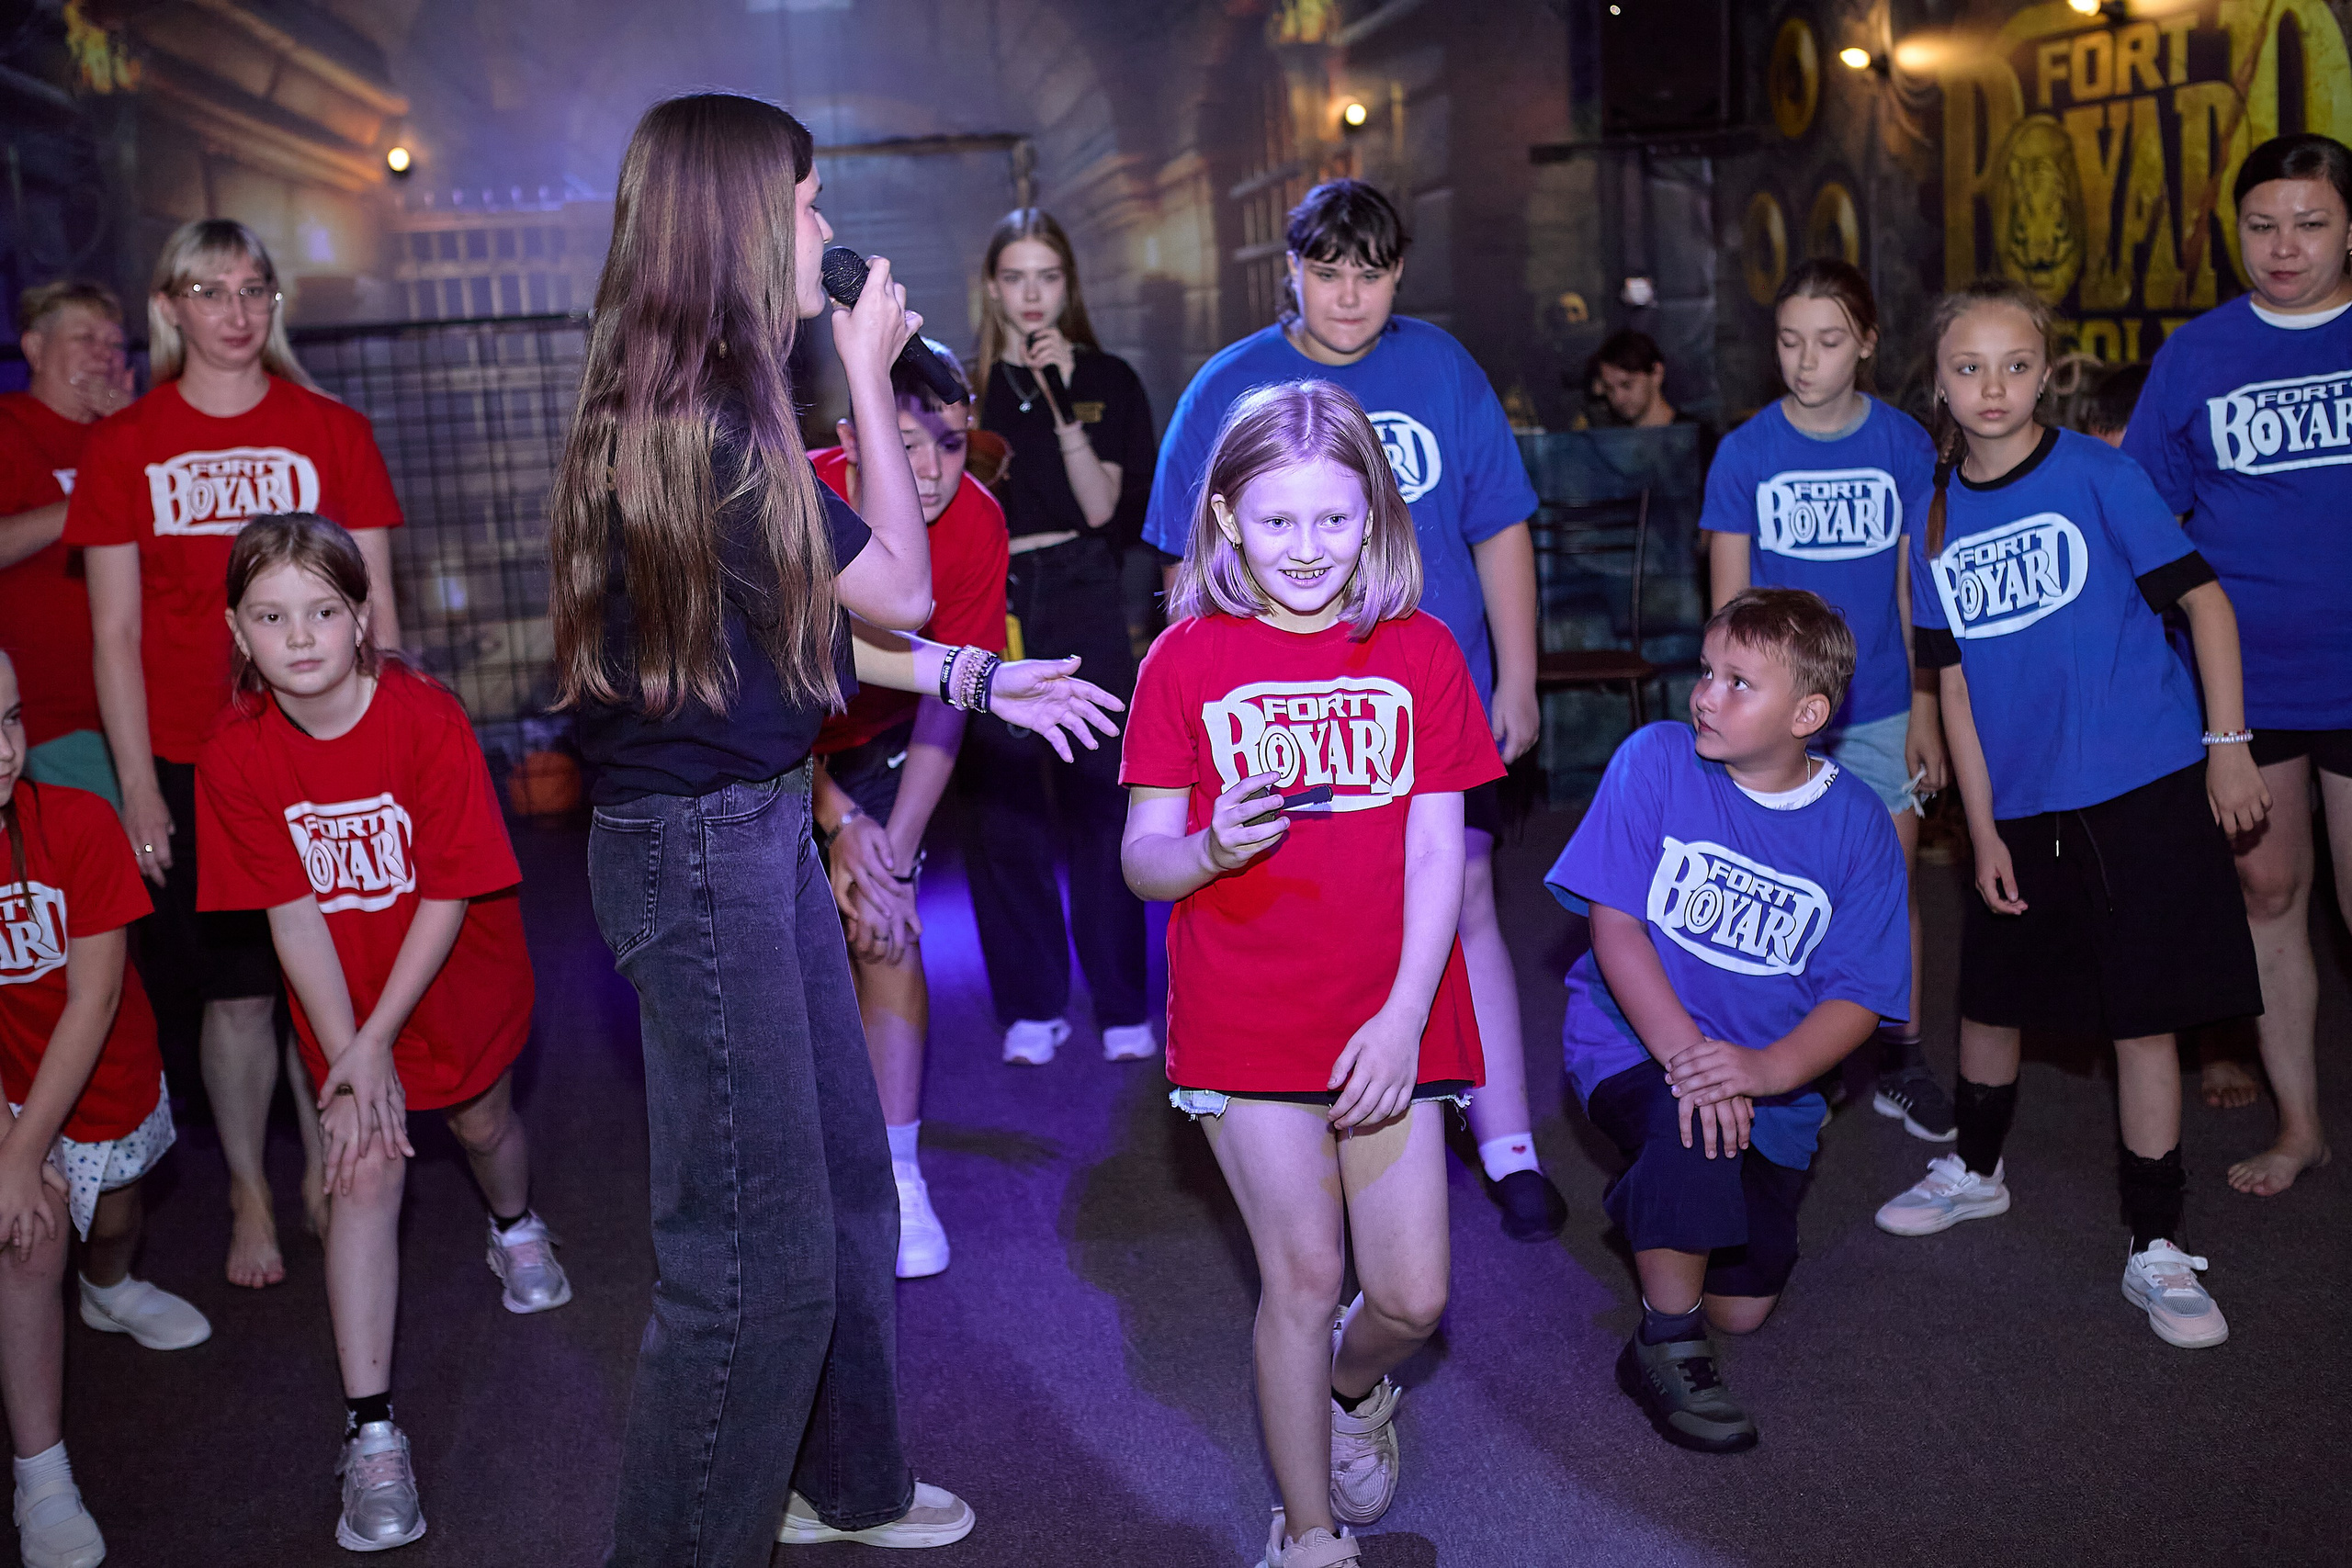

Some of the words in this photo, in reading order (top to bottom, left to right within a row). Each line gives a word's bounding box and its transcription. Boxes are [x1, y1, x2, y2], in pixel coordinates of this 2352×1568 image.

[2036, 11, 2199, 107] FORT
[2256, 380, 2348, 409] FORT
[144, 448, 320, 536] BOYARD
[189, 460, 268, 478] FORT
[1793, 480, 1866, 501] FORT
[1756, 468, 1903, 561] BOYARD
[1958, 528, 2037, 570] FORT
[1930, 513, 2088, 638] BOYARD
[1261, 692, 1369, 722] FORT
[1201, 677, 1416, 799] BOYARD
[303, 810, 380, 840] FORT
[1646, 836, 1833, 976] BOYARD
[1707, 859, 1795, 908] FORT
